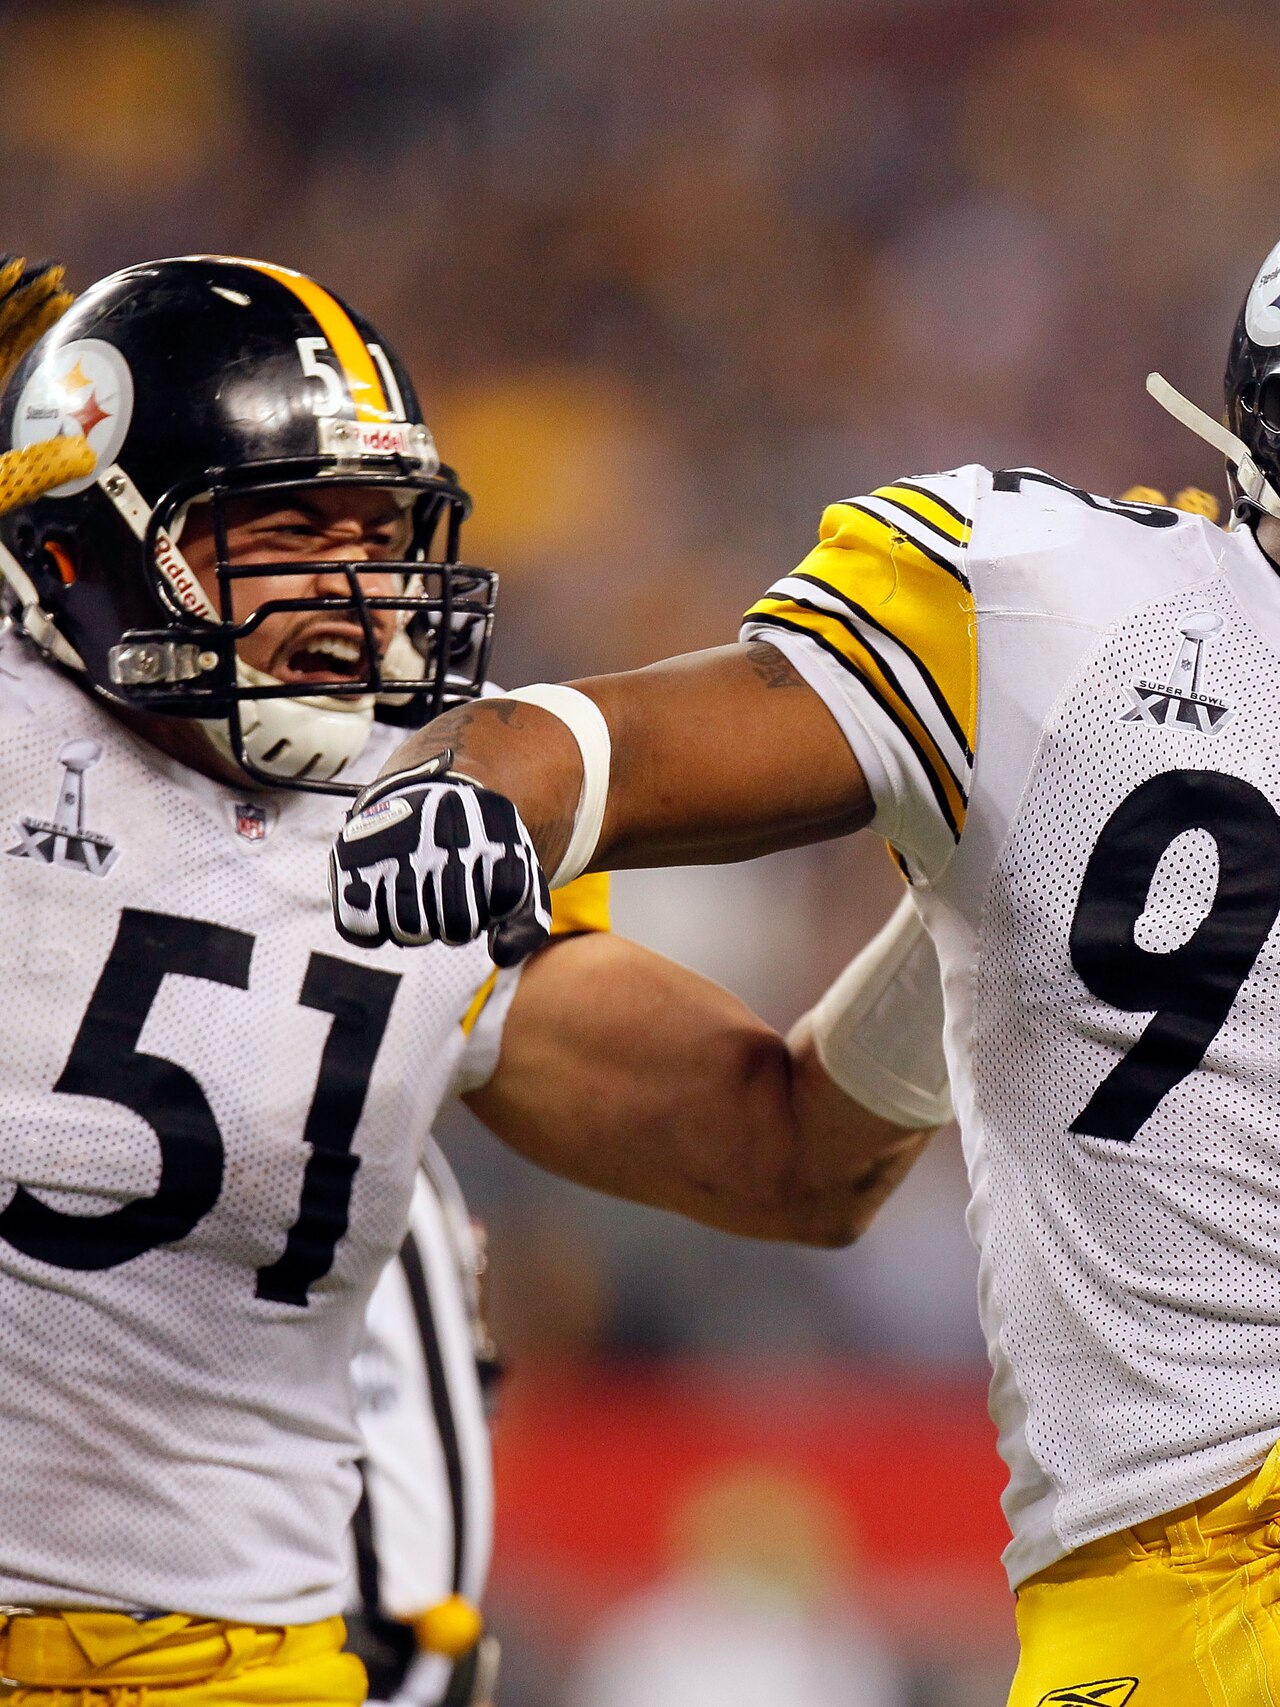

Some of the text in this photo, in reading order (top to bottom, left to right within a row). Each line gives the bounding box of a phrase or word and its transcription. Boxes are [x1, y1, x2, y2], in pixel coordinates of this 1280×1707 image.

[296, 336, 407, 422] 51
[154, 535, 209, 618] Riddell
[1119, 686, 1235, 735] XLV
[1139, 680, 1225, 707] SUPER BOWL
[4, 824, 120, 877] XLV
[0, 906, 402, 1307] 51
